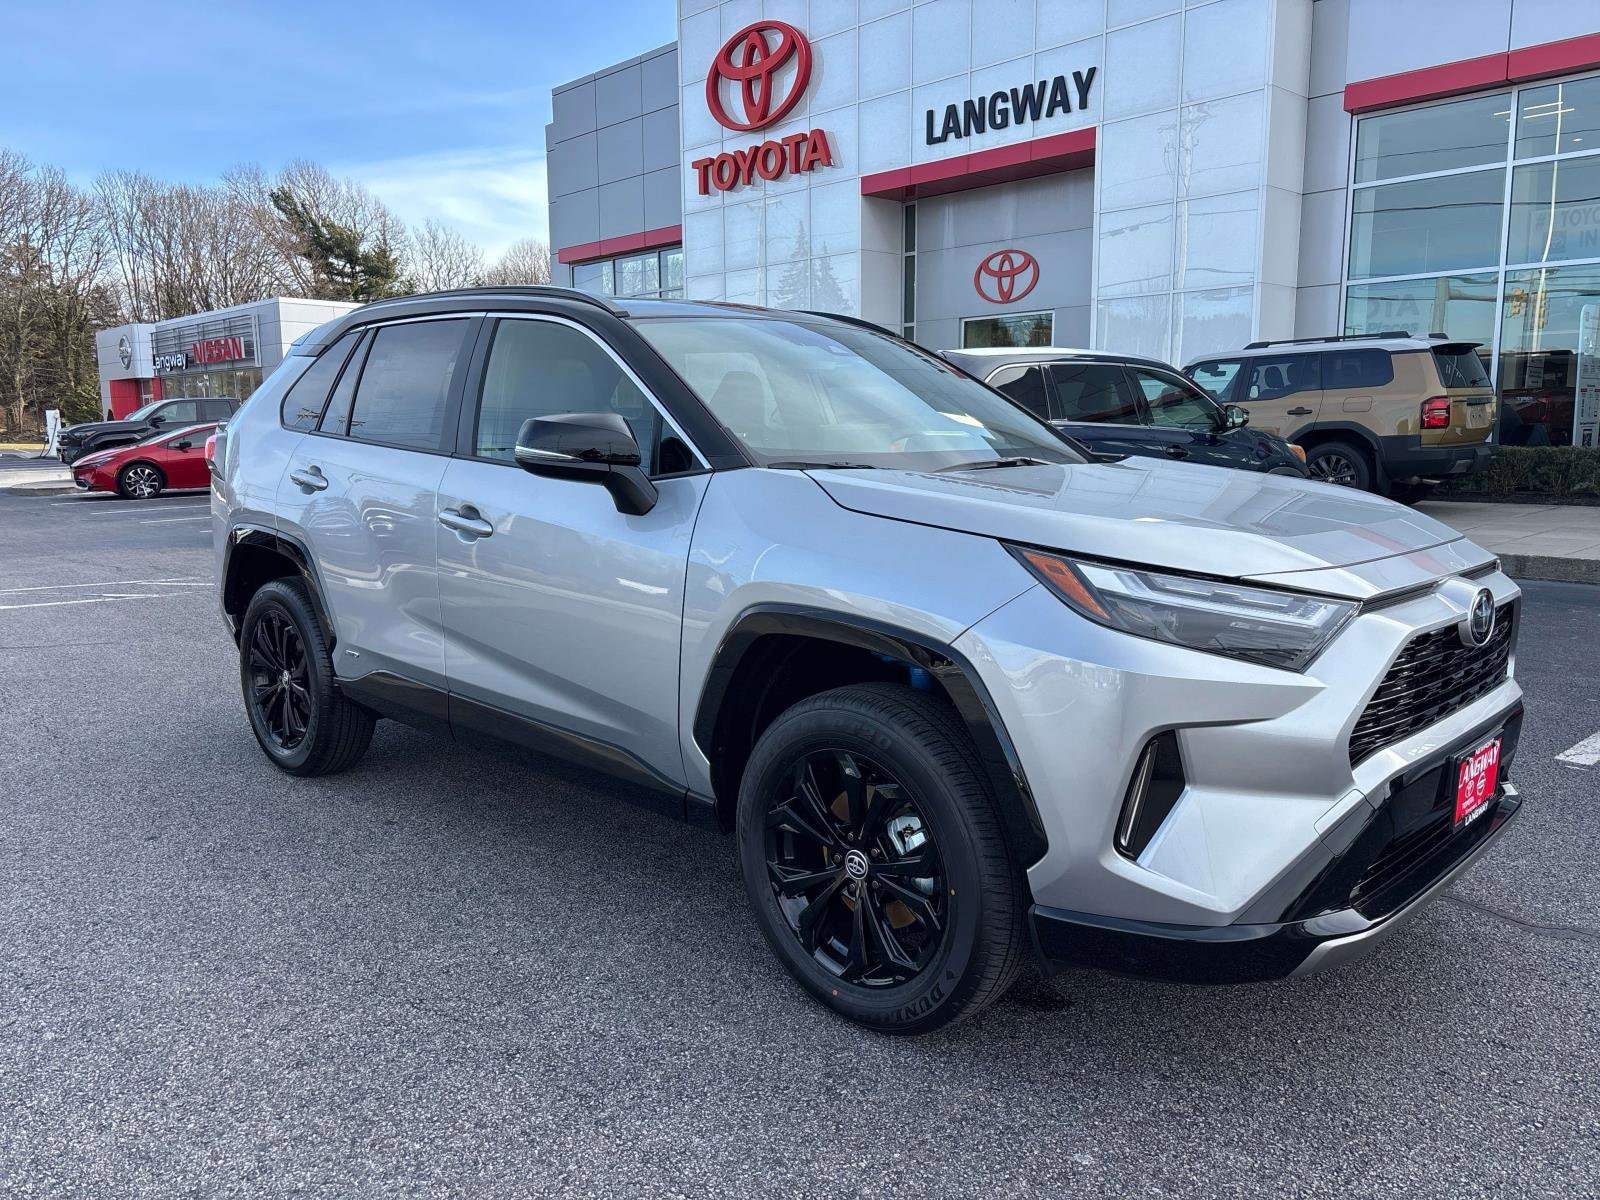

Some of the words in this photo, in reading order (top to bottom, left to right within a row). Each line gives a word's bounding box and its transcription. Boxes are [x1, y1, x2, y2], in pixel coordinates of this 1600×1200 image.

[926, 66, 1097, 145] LANGWAY
[692, 128, 833, 195] TOYOTA
[152, 353, 187, 371] Langway
[192, 336, 245, 364] NISSAN
[1459, 744, 1500, 789] LANGWAY
